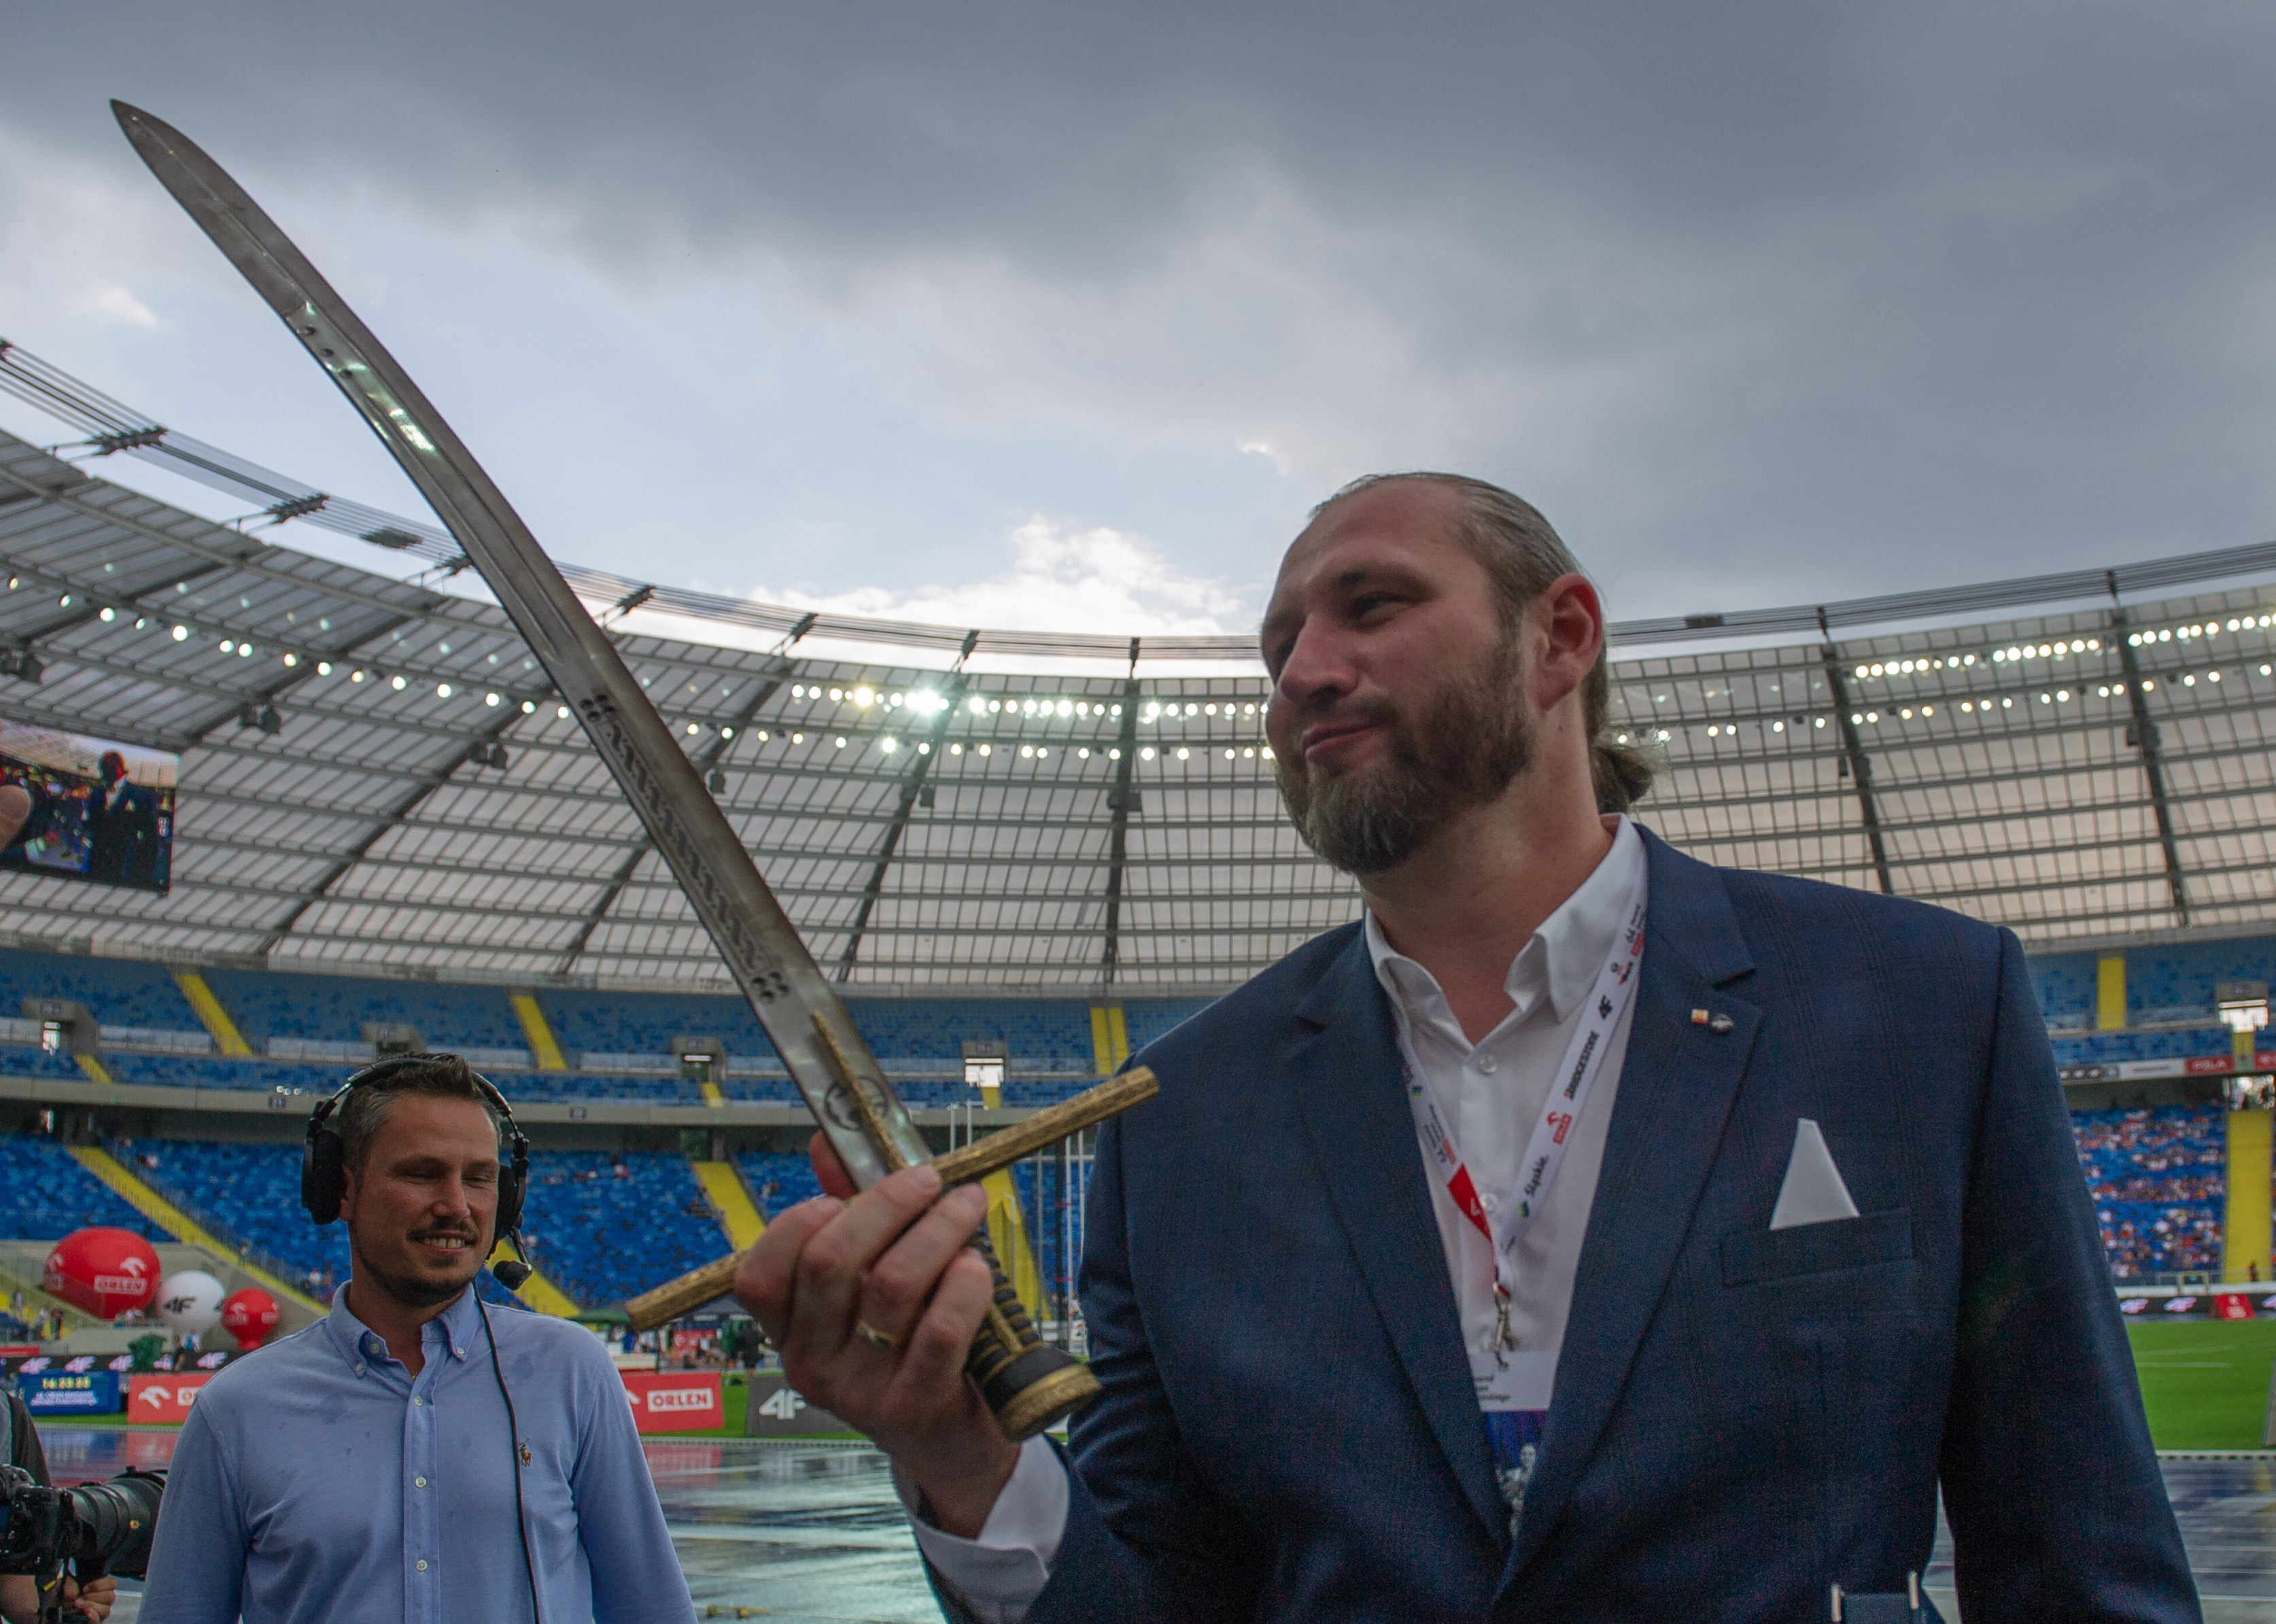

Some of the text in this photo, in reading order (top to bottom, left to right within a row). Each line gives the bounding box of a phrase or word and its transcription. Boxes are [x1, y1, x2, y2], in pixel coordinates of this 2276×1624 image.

[163, 1296, 196, 1313] 4F
[652, 1394, 708, 1407] ORLEN
[759, 1388, 806, 1420] 4F
